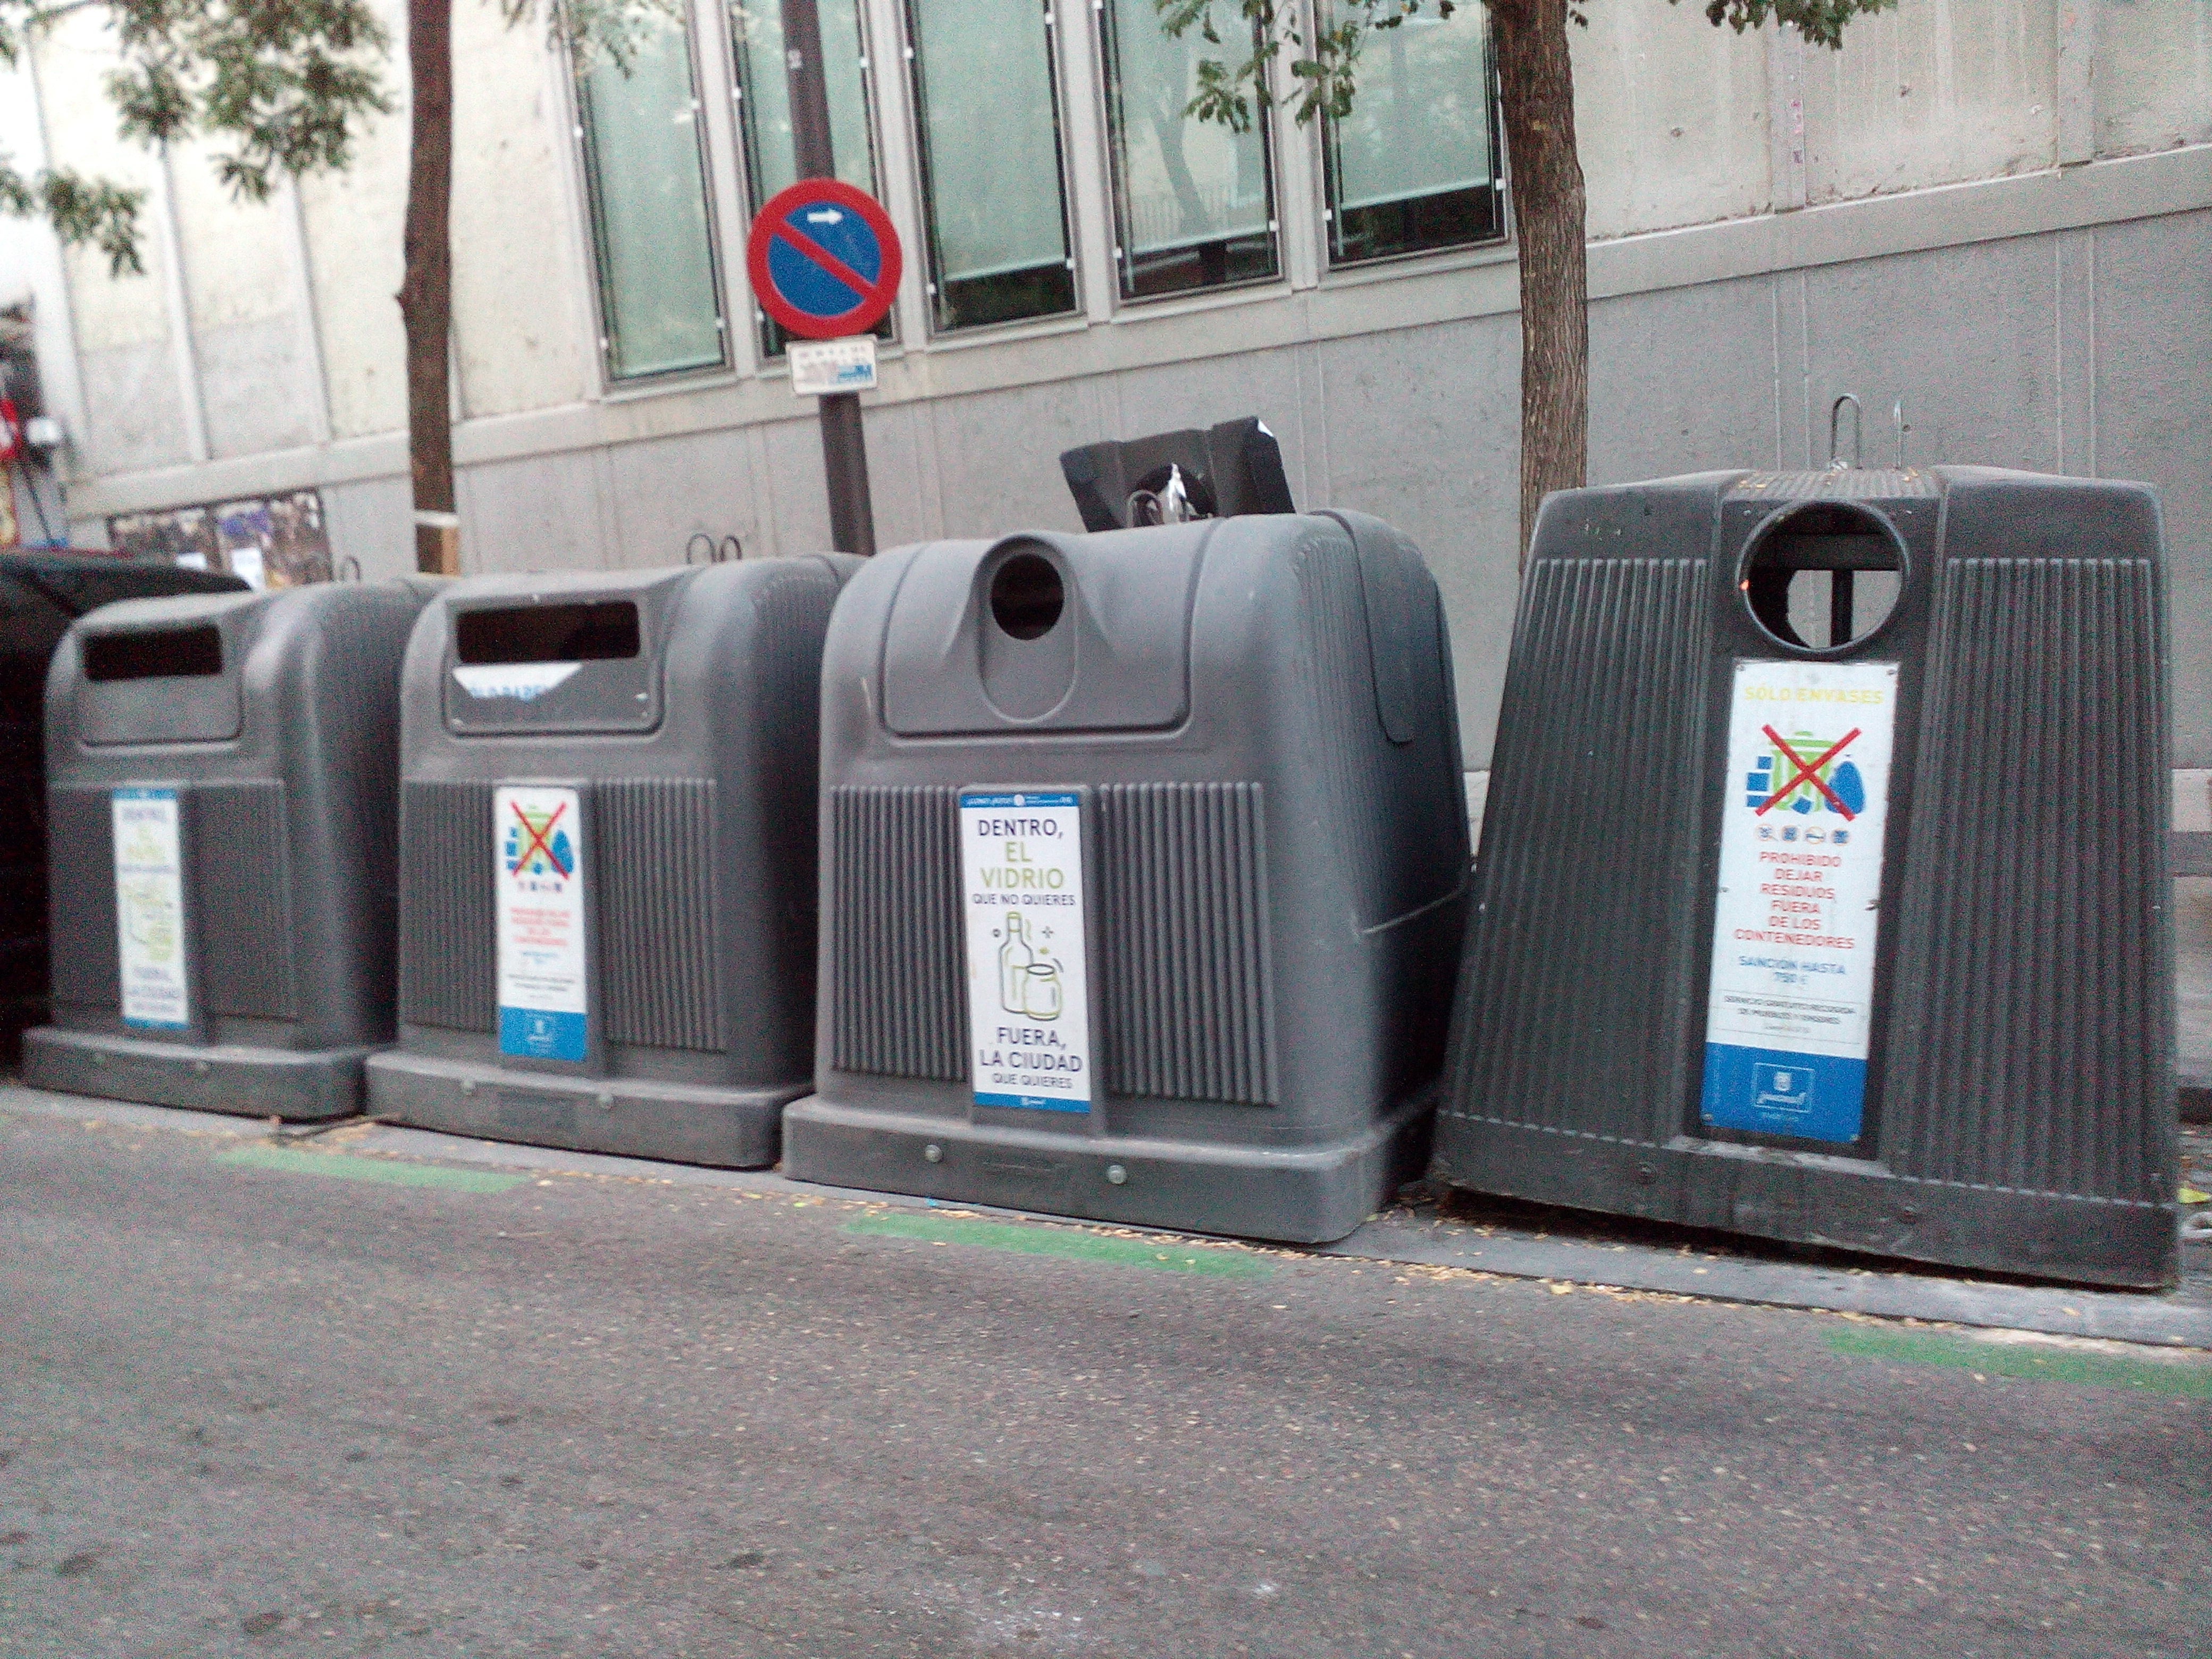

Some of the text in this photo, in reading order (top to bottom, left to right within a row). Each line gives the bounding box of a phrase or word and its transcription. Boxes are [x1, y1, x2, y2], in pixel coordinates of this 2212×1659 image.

[1745, 683, 1884, 705] SÓLO ENVASES
[978, 819, 1063, 839] DENTRO,
[1006, 841, 1033, 862] EL
[1760, 852, 1841, 867] PROHIBIDO
[979, 867, 1064, 889] VIDRIO
[1775, 868, 1823, 882] DEJAR
[973, 894, 1076, 906] QUE NO QUIERES
[1761, 883, 1835, 899] RESIDUOS
[1772, 900, 1820, 914] FUERA
[1769, 915, 1821, 931] DE LOS
[1735, 929, 1855, 949] CONTENEDORES
[998, 1027, 1066, 1050] FUERA,
[980, 1049, 1083, 1072] LA CIUDAD
[993, 1073, 1073, 1088] QUE QUIERES
